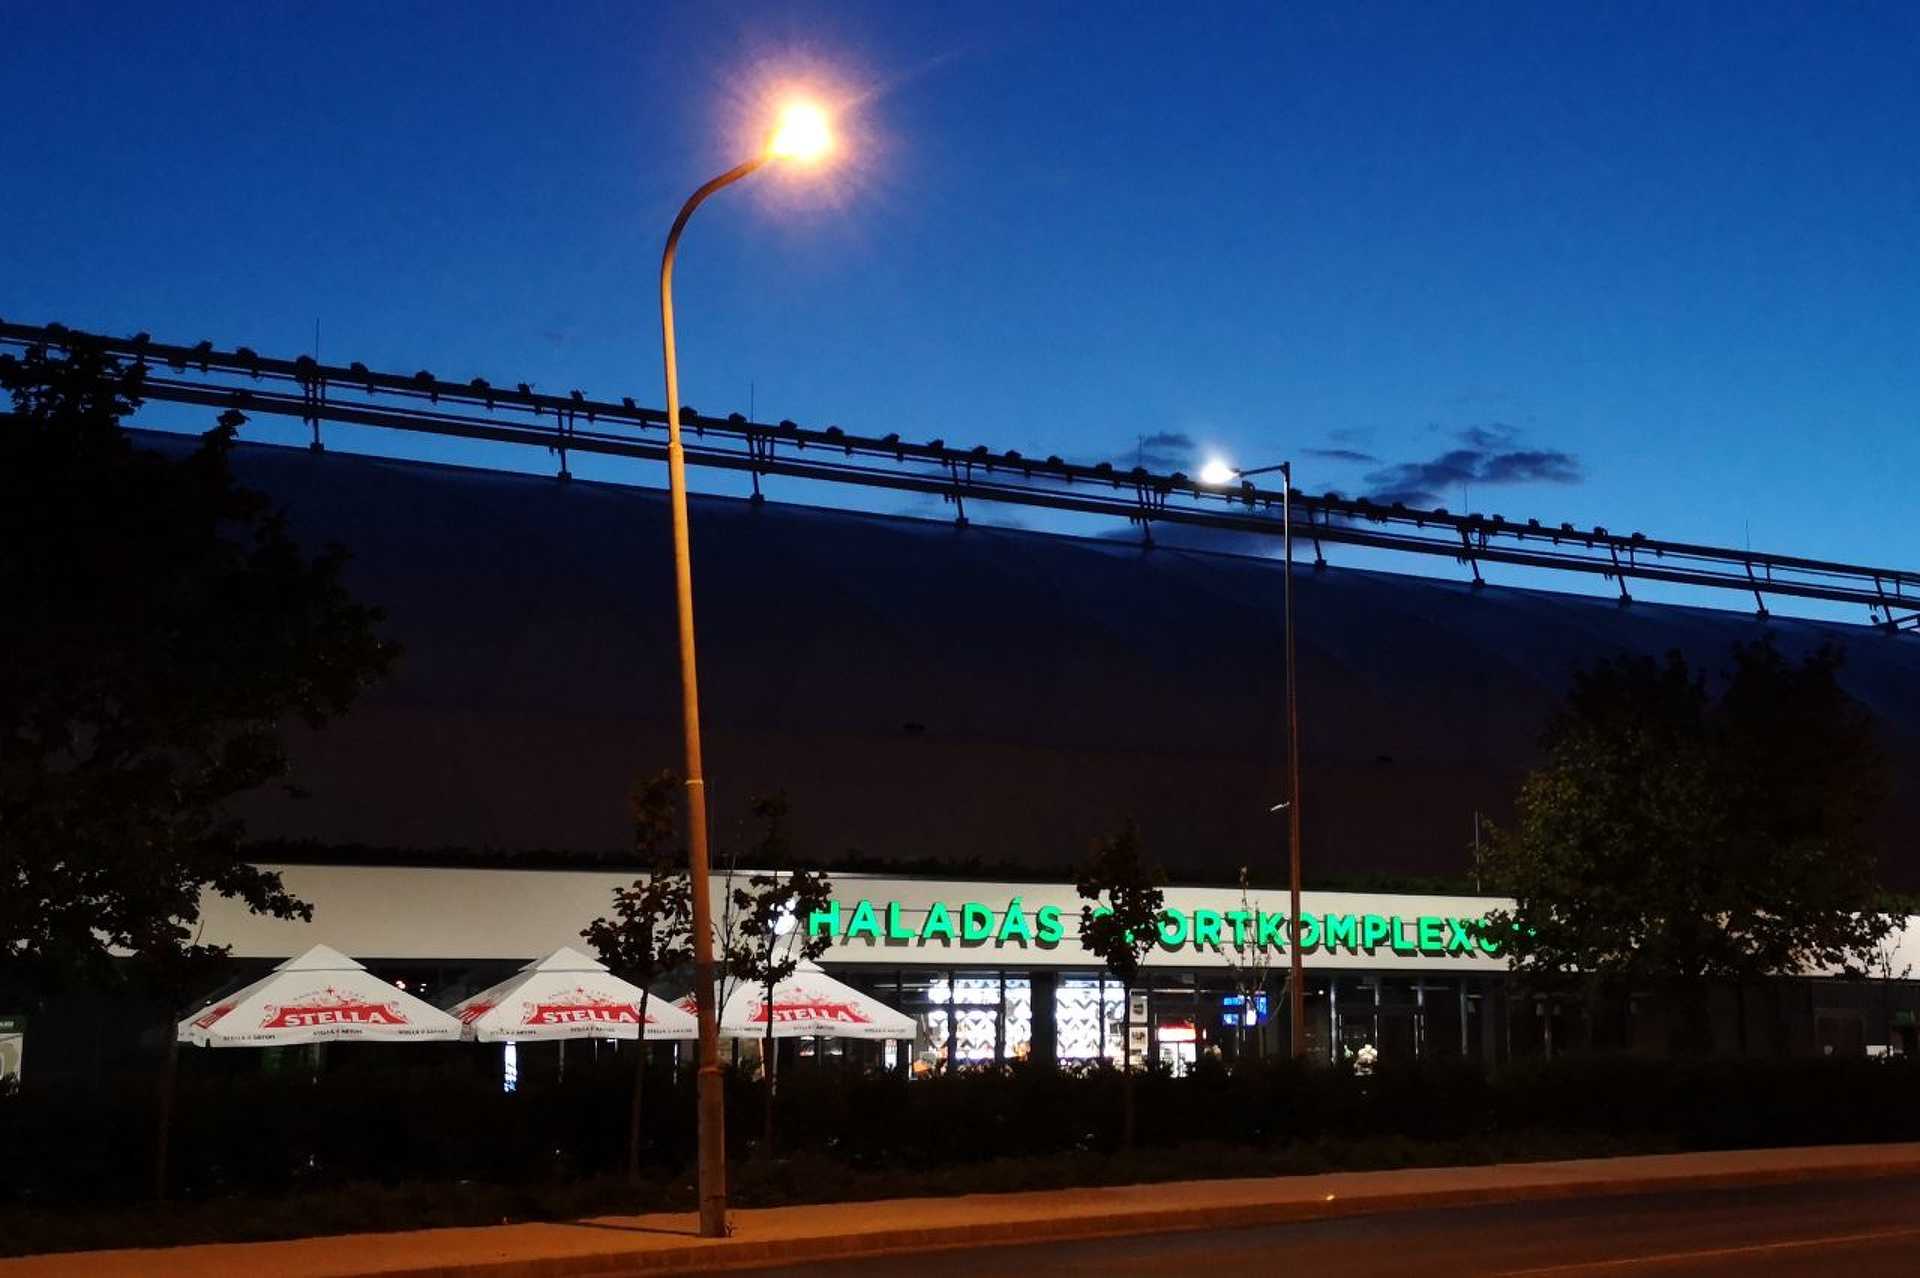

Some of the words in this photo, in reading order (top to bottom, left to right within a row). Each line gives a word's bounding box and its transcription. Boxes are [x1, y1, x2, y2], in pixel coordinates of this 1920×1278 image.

[808, 897, 1065, 943] HALADÁS
[283, 1010, 387, 1026] STELLA
[542, 1010, 637, 1024] STELLA
[772, 1008, 854, 1022] STELLA
